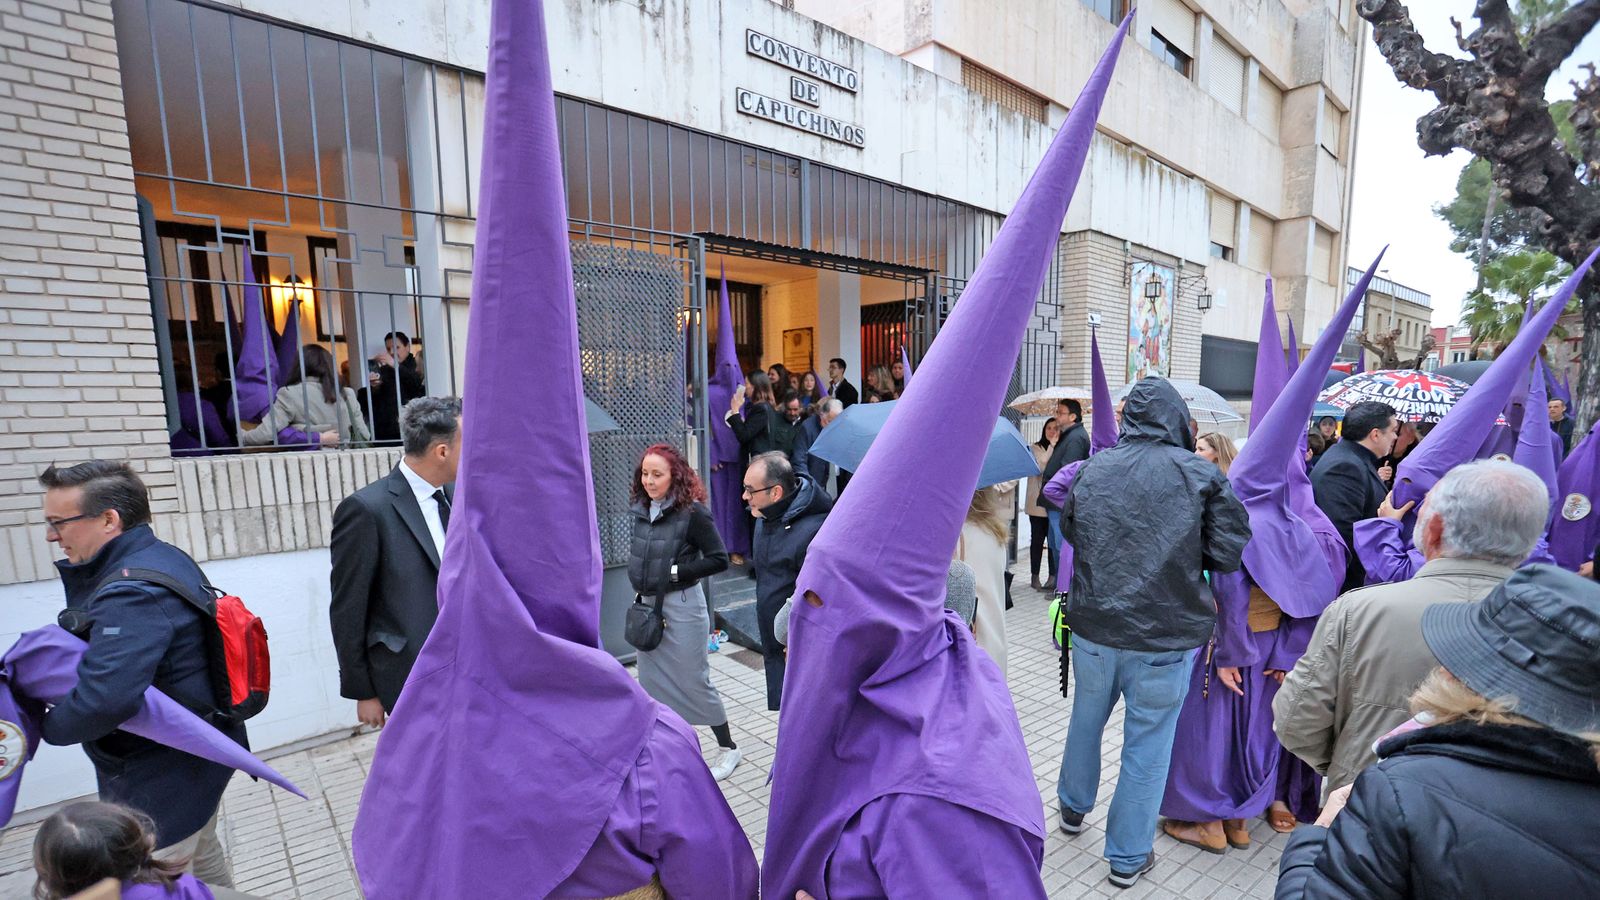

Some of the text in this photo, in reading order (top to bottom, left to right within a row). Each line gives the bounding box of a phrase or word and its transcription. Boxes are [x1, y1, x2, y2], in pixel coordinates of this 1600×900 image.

[749, 33, 857, 89] CONVENTO
[740, 91, 864, 144] CAPUCHINOS
[794, 79, 818, 103] DE
